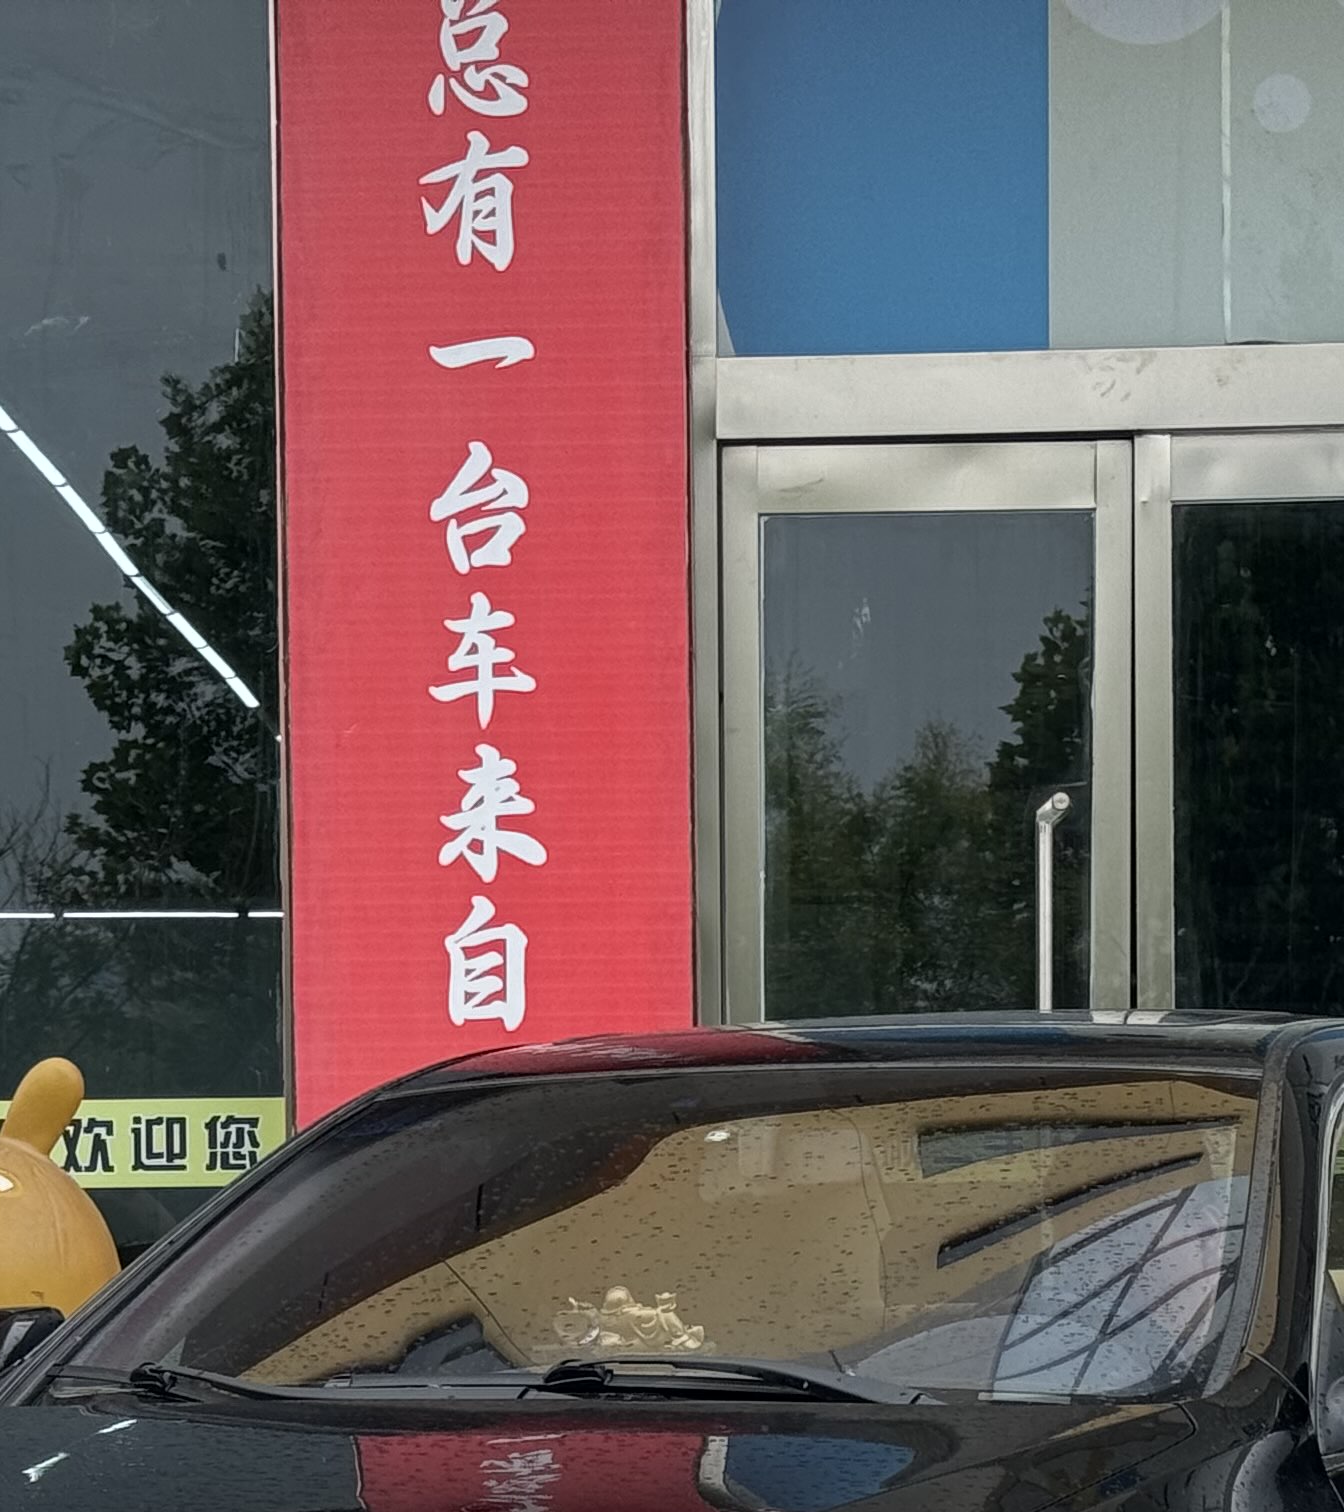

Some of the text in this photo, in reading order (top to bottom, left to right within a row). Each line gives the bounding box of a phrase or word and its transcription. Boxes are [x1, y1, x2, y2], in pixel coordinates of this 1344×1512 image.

[419, 0, 547, 1031] 总有一台车来自
